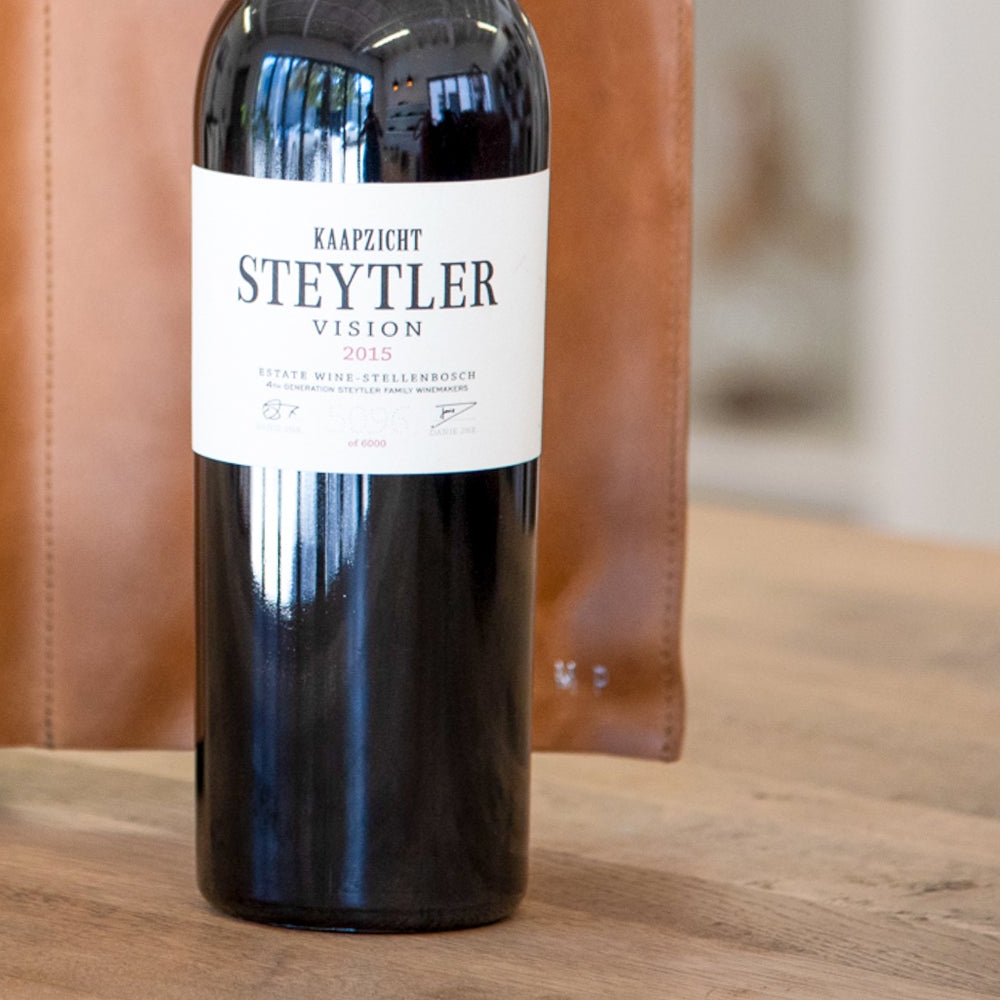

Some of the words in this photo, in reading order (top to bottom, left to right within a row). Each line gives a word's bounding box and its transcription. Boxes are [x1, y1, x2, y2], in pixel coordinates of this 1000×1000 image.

[313, 227, 422, 252] KAAPZICHT
[237, 254, 499, 311] STEYTLER
[312, 319, 423, 338] VISION
[342, 346, 393, 362] 2015
[258, 367, 308, 380] ESTATE
[283, 383, 335, 393] GENERATION
[338, 386, 381, 394] STEYTLER
[384, 386, 413, 394] FAMILY
[416, 384, 469, 394] WINEMAKERS
[347, 439, 359, 448] of
[360, 439, 387, 448] 6000
